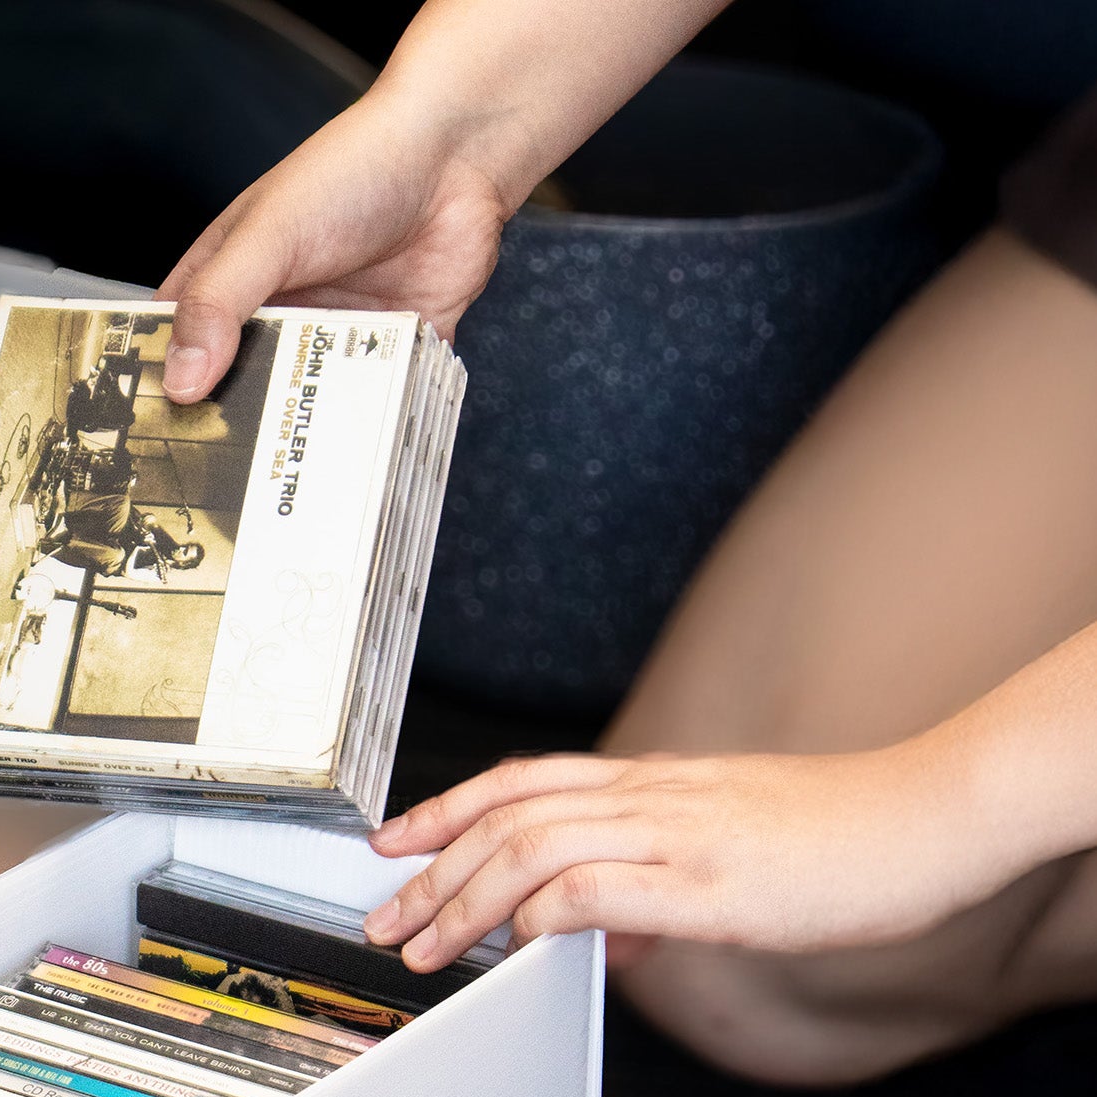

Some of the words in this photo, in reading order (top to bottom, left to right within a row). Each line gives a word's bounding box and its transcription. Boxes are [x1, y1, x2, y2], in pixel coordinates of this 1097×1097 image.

[306, 325, 328, 378] JOHN
[326, 332, 336, 351] THE
[289, 323, 313, 389] SUNRISE
[278, 398, 298, 440] OVER
[288, 384, 317, 463] BUTLER
[269, 449, 287, 480] SEA
[277, 470, 300, 516] TRIO
[15, 756, 38, 764] TRIO
[58, 759, 100, 769] SUNRISE
[104, 763, 131, 771] OVER
[62, 955, 80, 968] the
[82, 957, 108, 975] 80s
[34, 982, 55, 994] THE
[53, 989, 88, 1004] MUSIC
[202, 997, 238, 1013] volume
[41, 1009, 57, 1018] U2
[60, 1015, 79, 1025] ALL
[83, 1021, 112, 1036] THAT
[114, 1030, 137, 1042] YOU
[139, 1038, 174, 1052] CAN'T
[174, 1048, 207, 1063] LEAVE
[209, 1059, 252, 1077] BEHIND
[67, 1055, 121, 1077] PARTIES
[22, 1083, 43, 1097] CD
